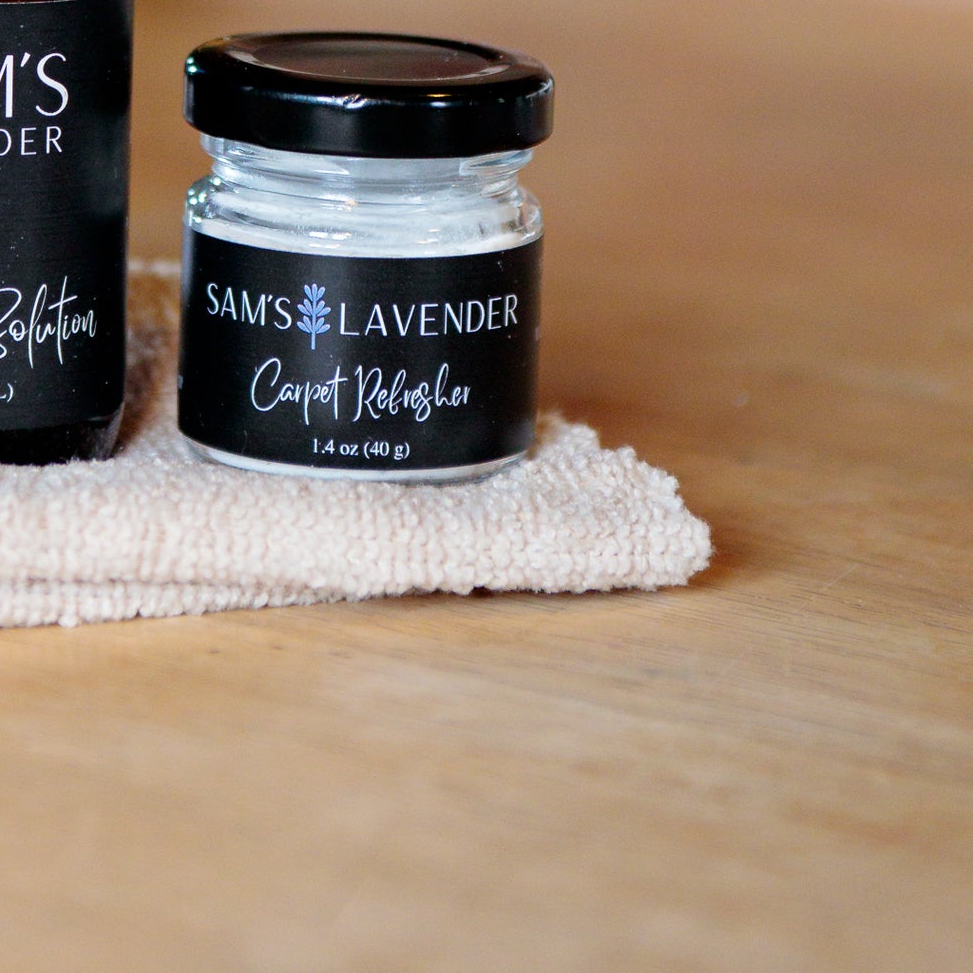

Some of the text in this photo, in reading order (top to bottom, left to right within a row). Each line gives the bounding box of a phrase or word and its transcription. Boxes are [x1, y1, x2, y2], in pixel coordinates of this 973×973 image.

[207, 282, 518, 337] SAM'S LAVENDER
[250, 357, 471, 426] Carpet Refresher
[313, 438, 410, 461] 1.4 oz (40 g)
